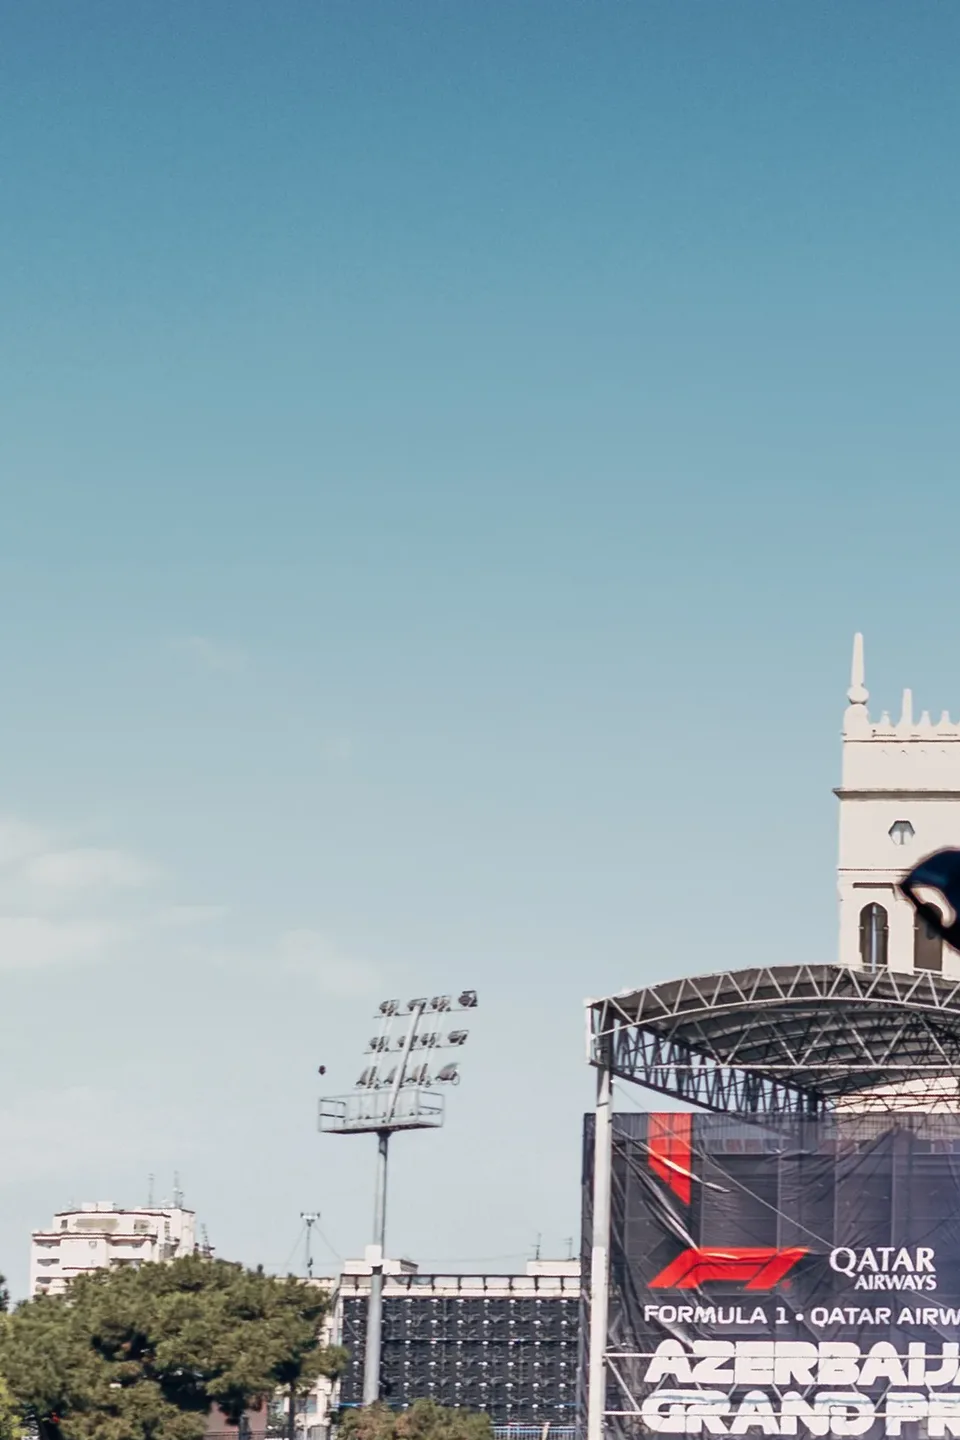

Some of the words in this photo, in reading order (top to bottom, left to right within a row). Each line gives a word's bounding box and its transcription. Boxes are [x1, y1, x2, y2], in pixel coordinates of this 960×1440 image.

[829, 1246, 936, 1275] QATAR
[854, 1273, 937, 1290] AIRWAYS
[644, 1305, 768, 1325] FORMULA
[776, 1307, 789, 1325] 1
[811, 1307, 890, 1328] QATAR
[641, 1389, 876, 1437] GRAND
